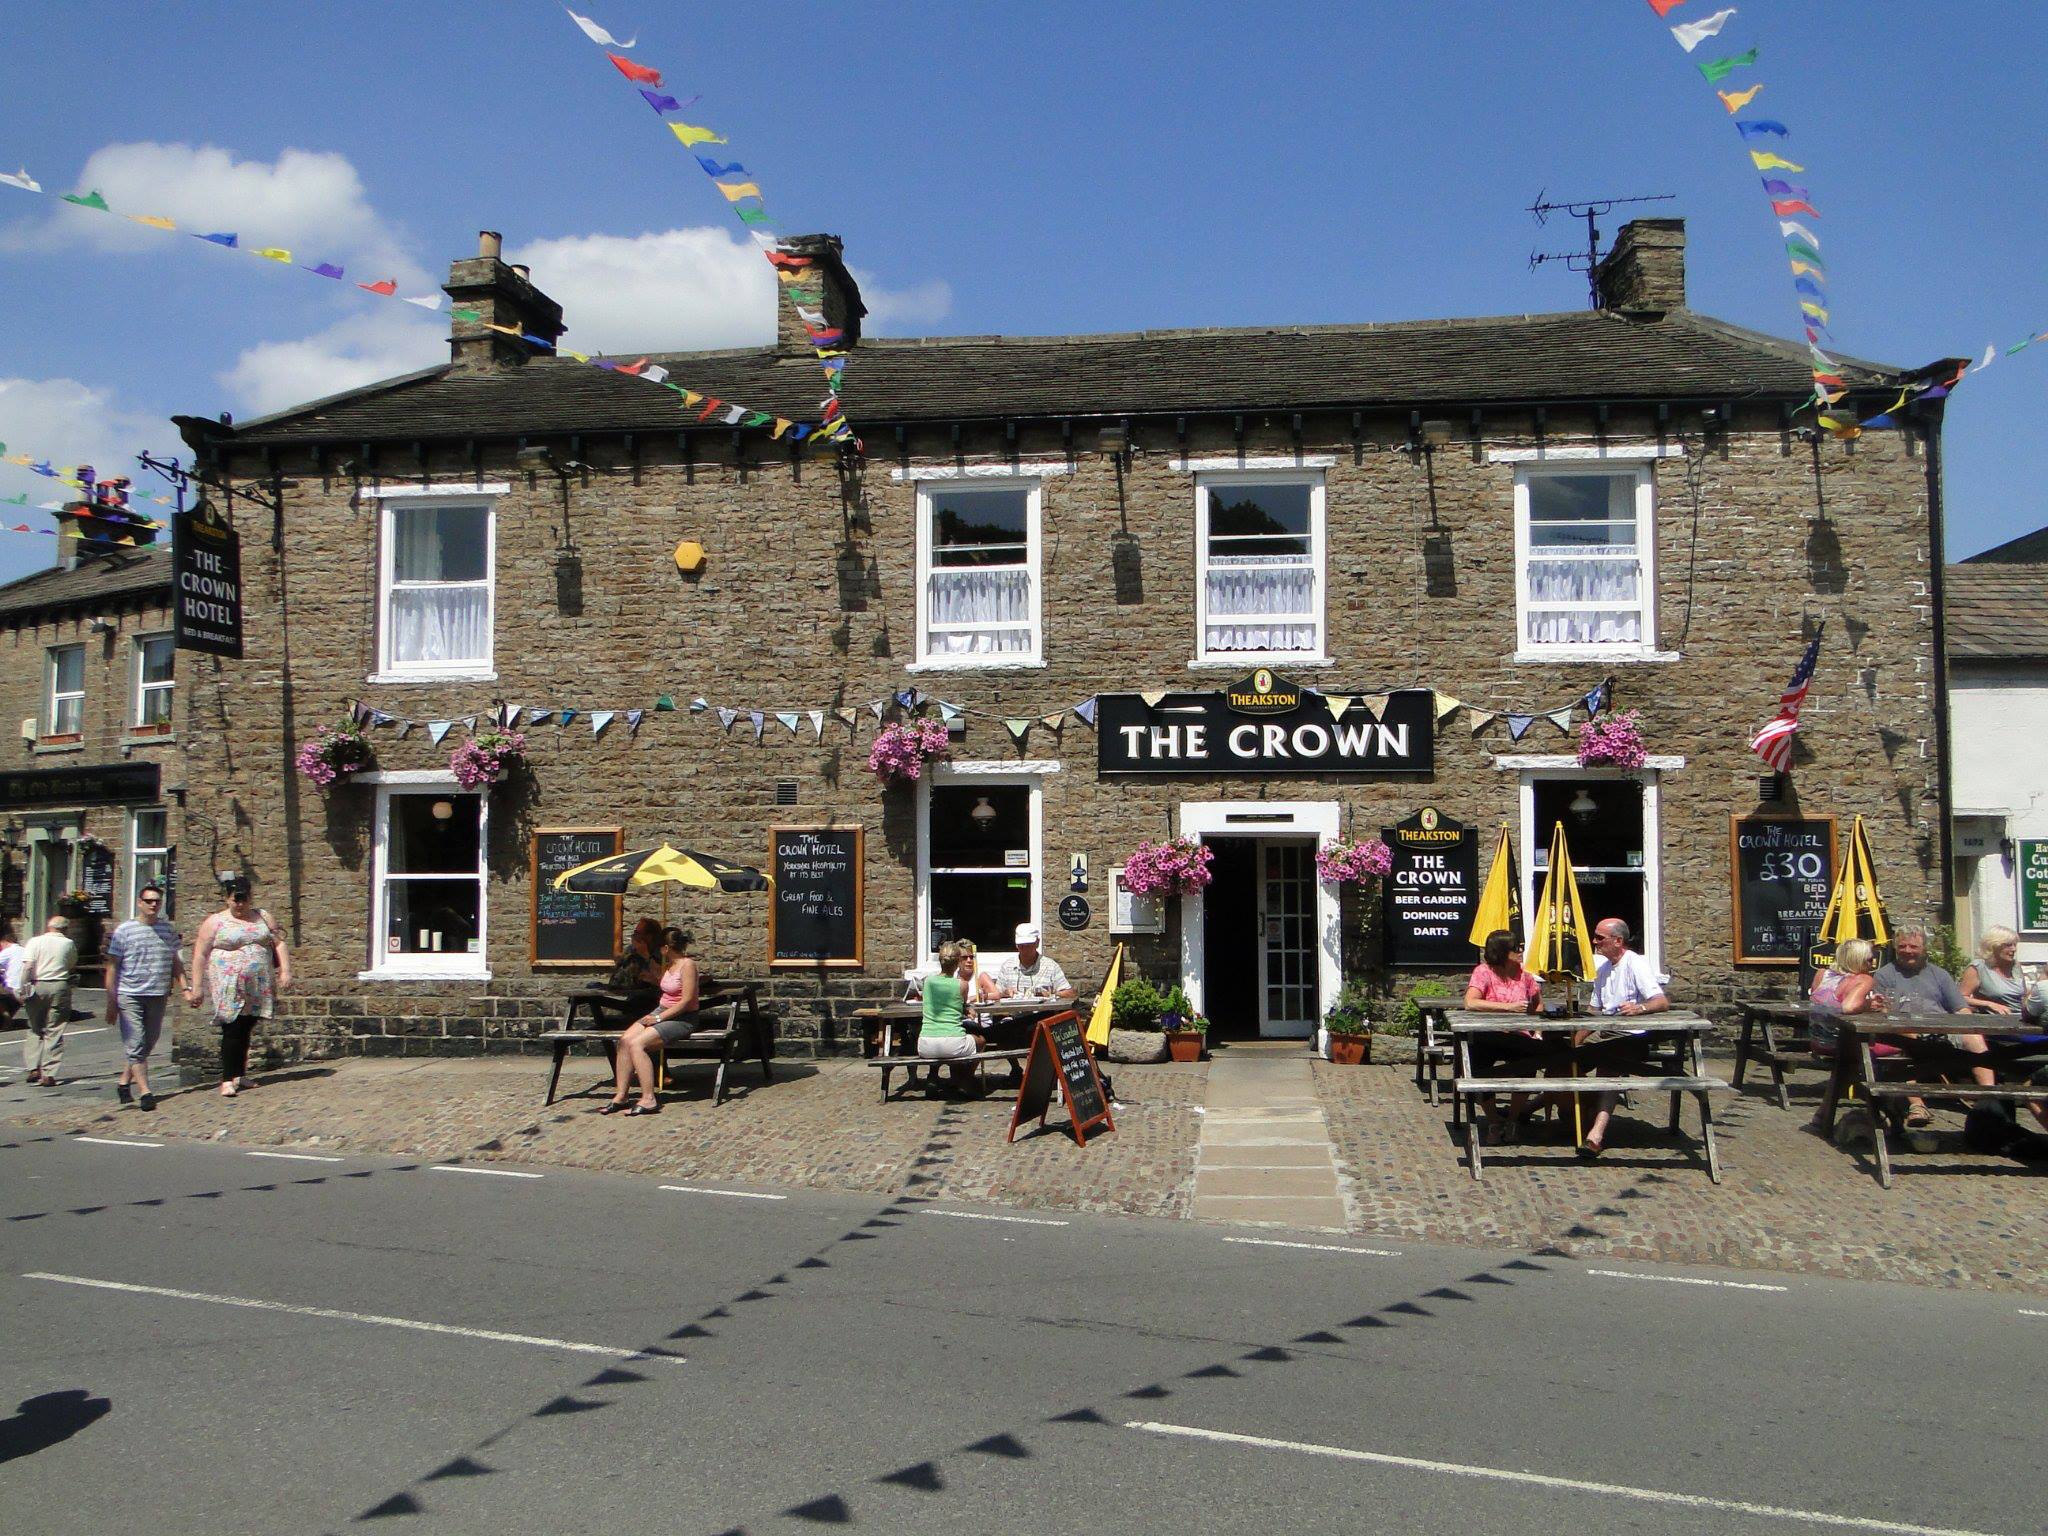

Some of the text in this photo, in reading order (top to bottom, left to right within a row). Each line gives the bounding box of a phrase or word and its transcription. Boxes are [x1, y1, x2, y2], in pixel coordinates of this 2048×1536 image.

[194, 550, 222, 573] THE
[181, 572, 236, 601] CROWN
[185, 598, 233, 625] HOTEL
[183, 627, 197, 637] BED
[203, 632, 237, 644] BREAKFAST
[1230, 693, 1296, 706] THEAKSTON
[1119, 724, 1412, 758] THE CROWN
[1399, 829, 1460, 841] THEAKSTON
[1764, 825, 1783, 836] THE
[800, 835, 820, 843] THE
[1739, 835, 1824, 848] CROWN HOTEL
[779, 844, 845, 856] CROWN HOTEL
[1412, 855, 1445, 869] THE
[1760, 852, 1822, 881] £30
[1396, 871, 1461, 885] CROWN
[1803, 884, 1827, 893] BED
[781, 890, 804, 901] GREAT
[809, 891, 823, 901] FOOD
[1395, 896, 1467, 904] BEER GARDEN
[801, 903, 843, 916] FINE ALES
[1804, 901, 1828, 910] FULL
[1402, 911, 1459, 920] DOMINOES
[1413, 927, 1449, 936] DARTS
